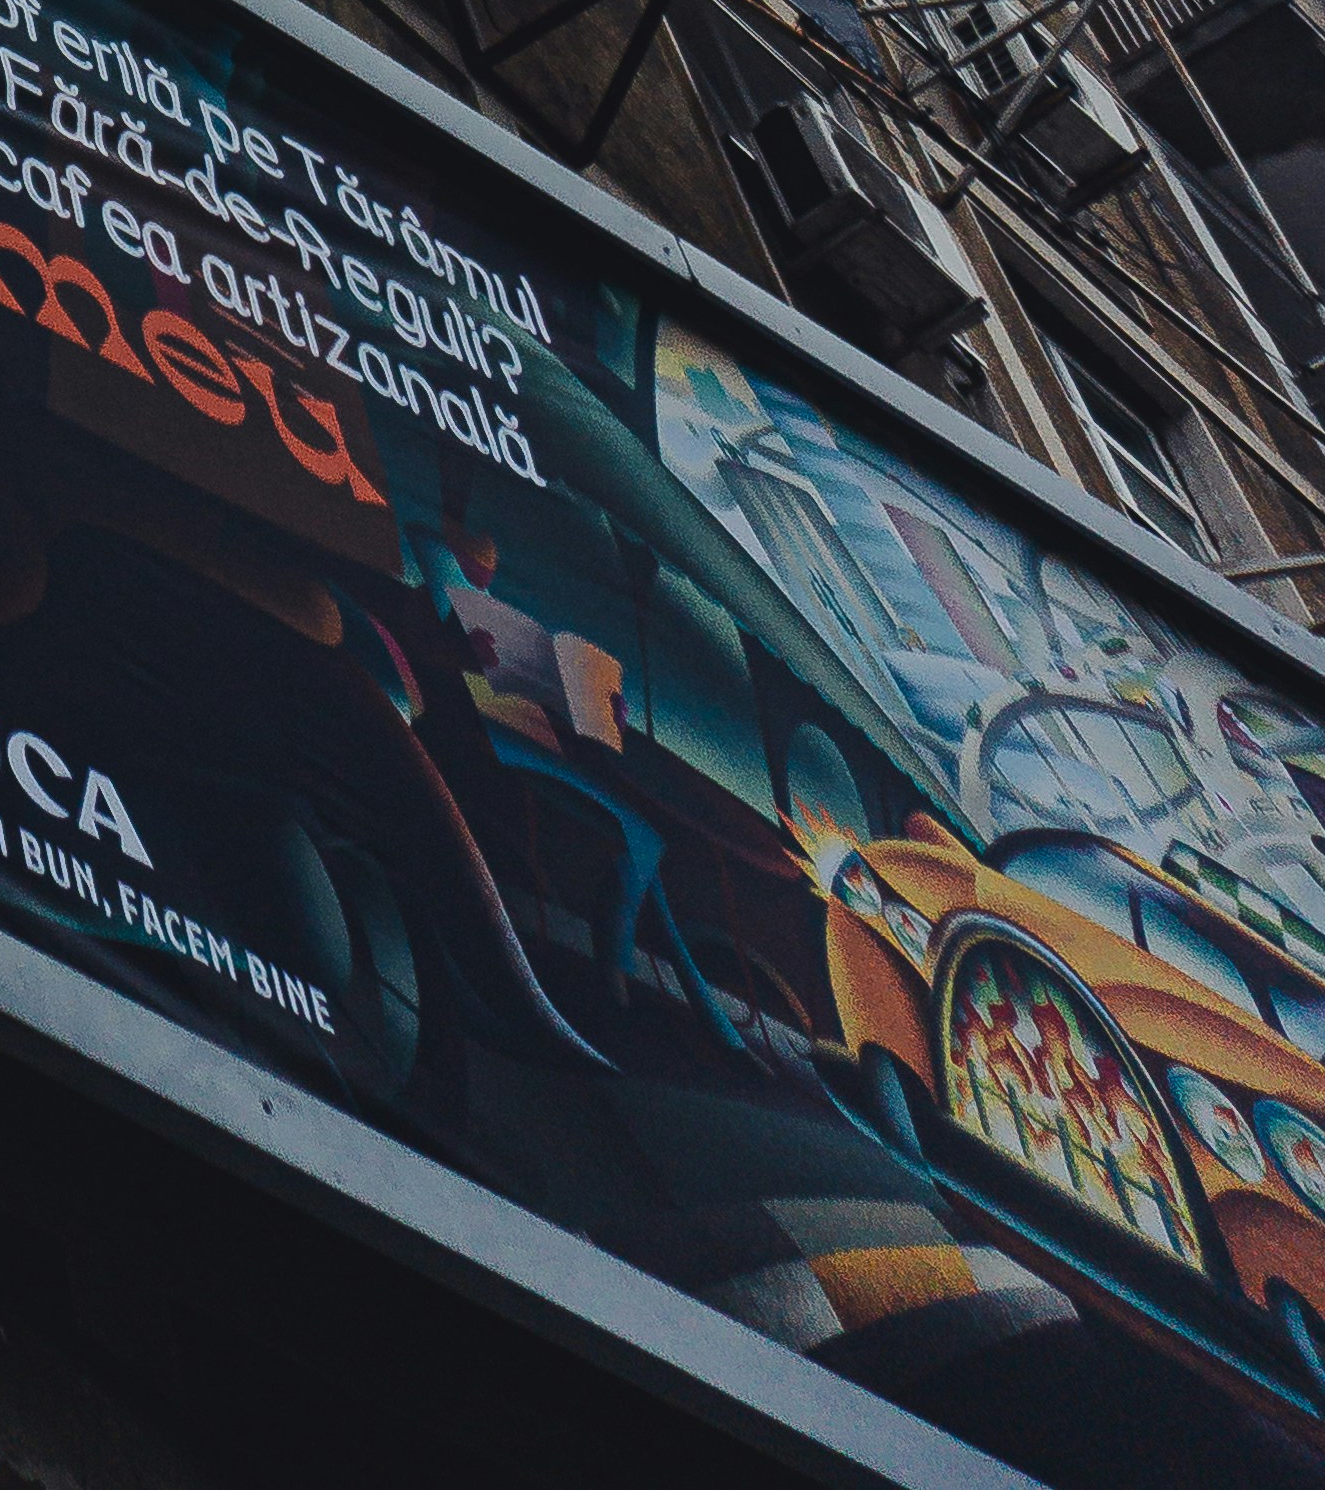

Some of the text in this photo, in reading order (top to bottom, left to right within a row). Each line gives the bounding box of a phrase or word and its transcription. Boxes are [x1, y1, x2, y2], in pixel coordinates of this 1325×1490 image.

[198, 99, 283, 178] pe
[282, 136, 550, 343] Tărâmul
[202, 254, 546, 487] artizanală
[19, 825, 111, 918] BUN,
[118, 880, 237, 981] FACEM
[246, 941, 334, 1035] BINE
